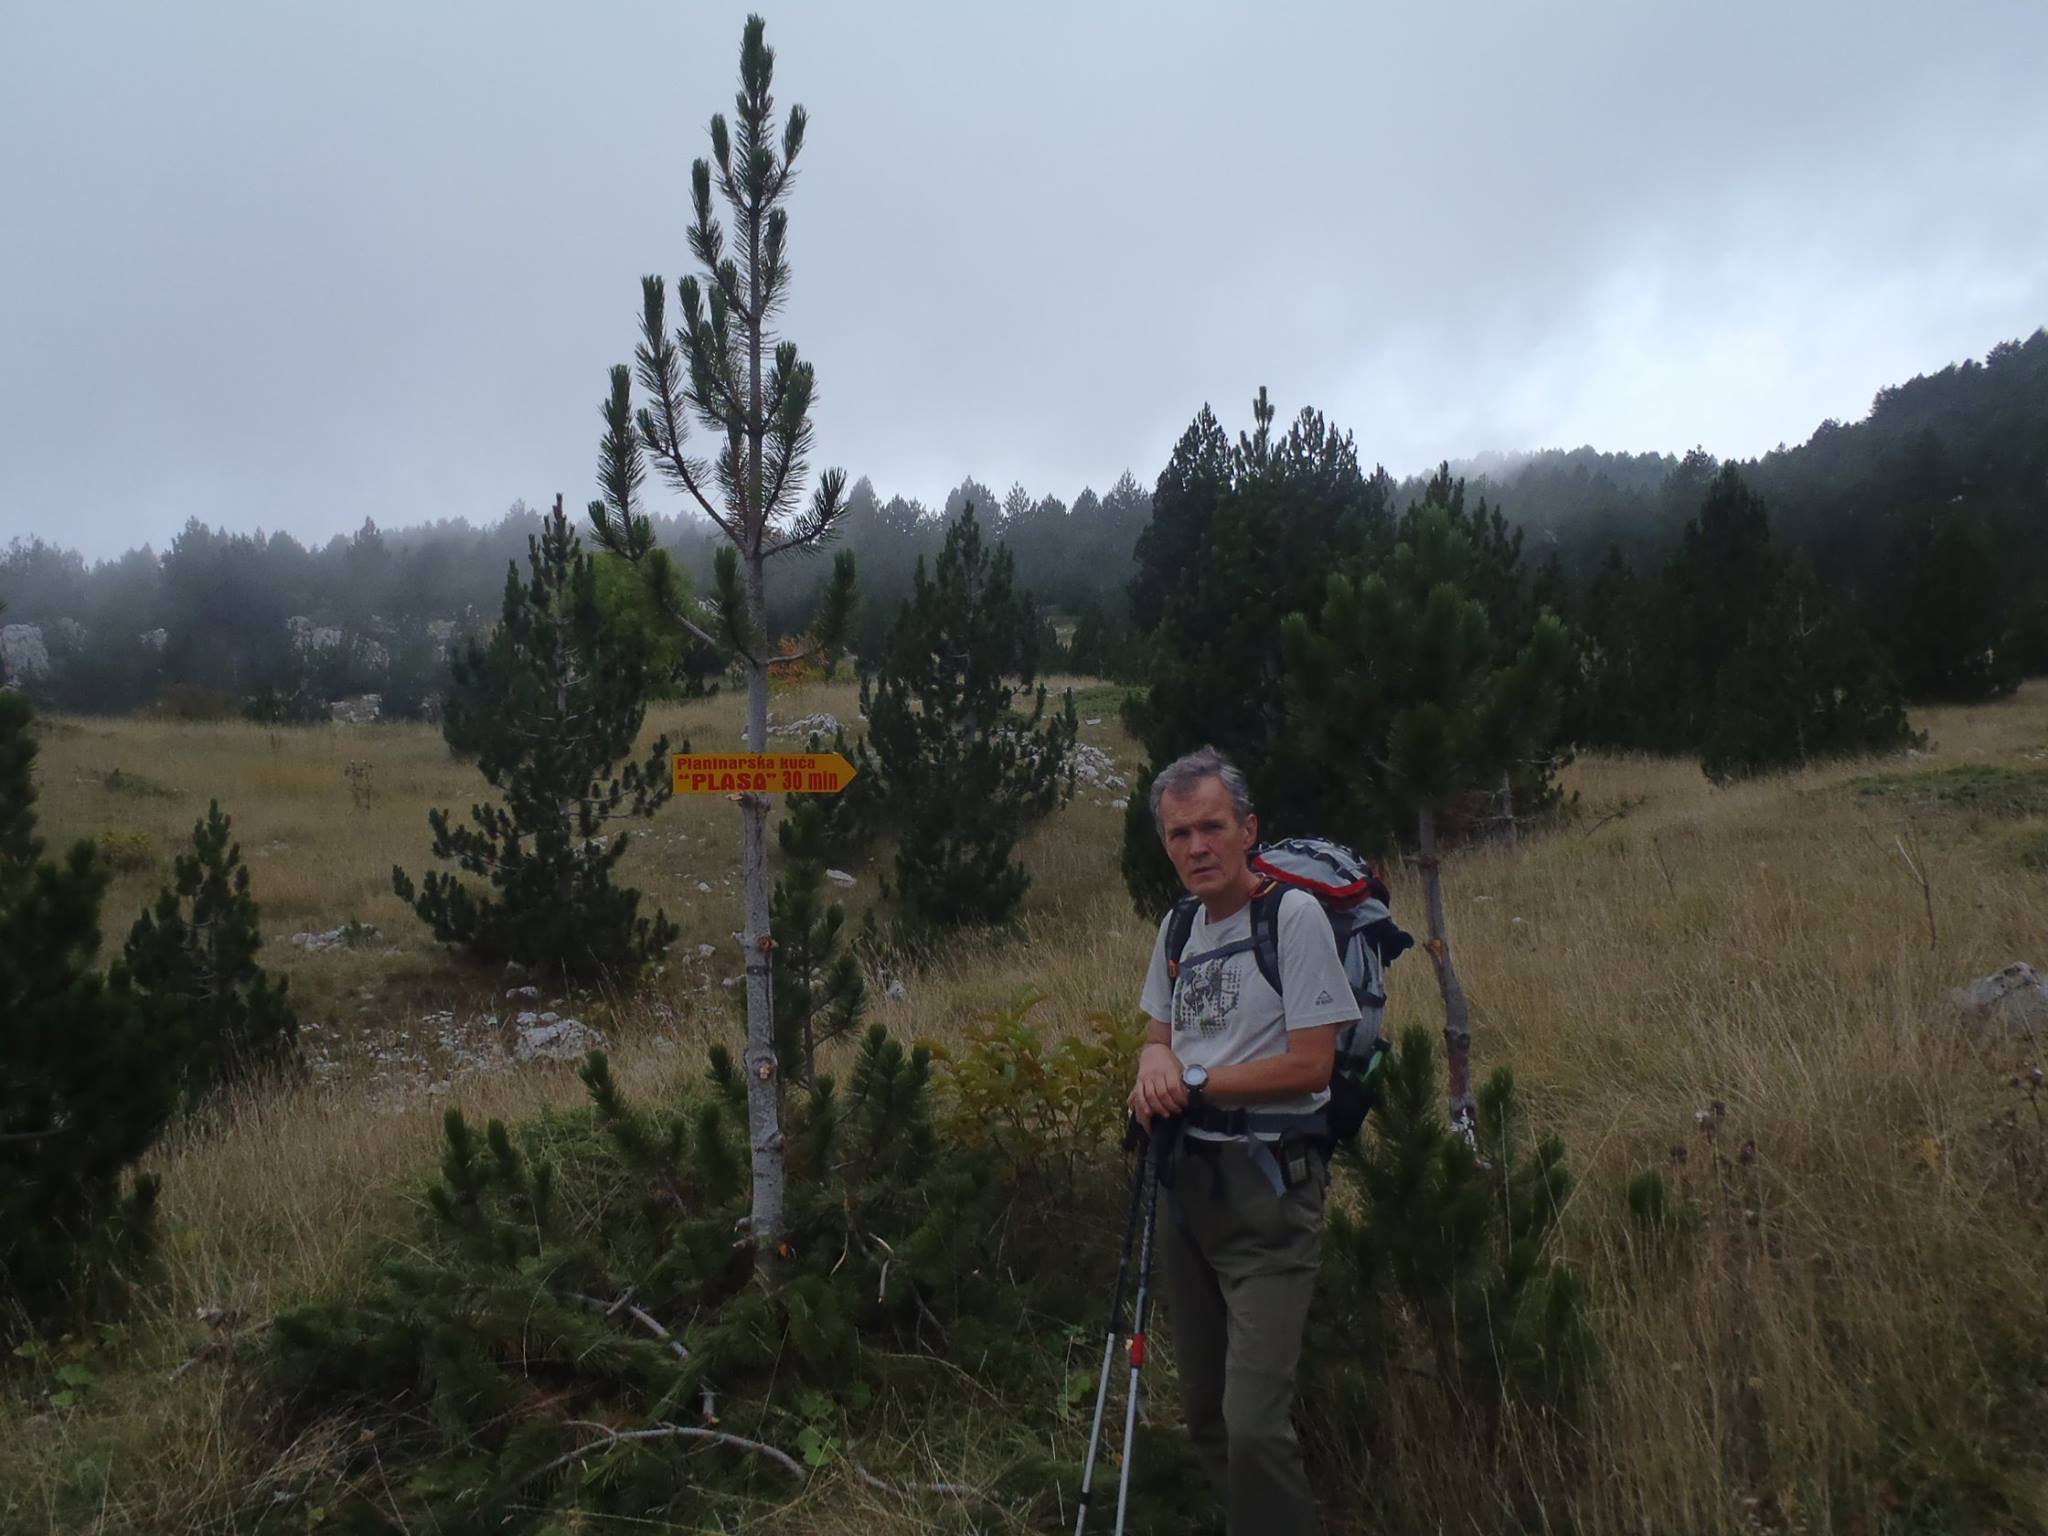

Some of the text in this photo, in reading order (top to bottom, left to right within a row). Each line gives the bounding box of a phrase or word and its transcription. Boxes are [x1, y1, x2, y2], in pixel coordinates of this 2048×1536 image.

[677, 757, 775, 770] Planinarska
[783, 771, 802, 790] 30
[808, 771, 838, 790] min
